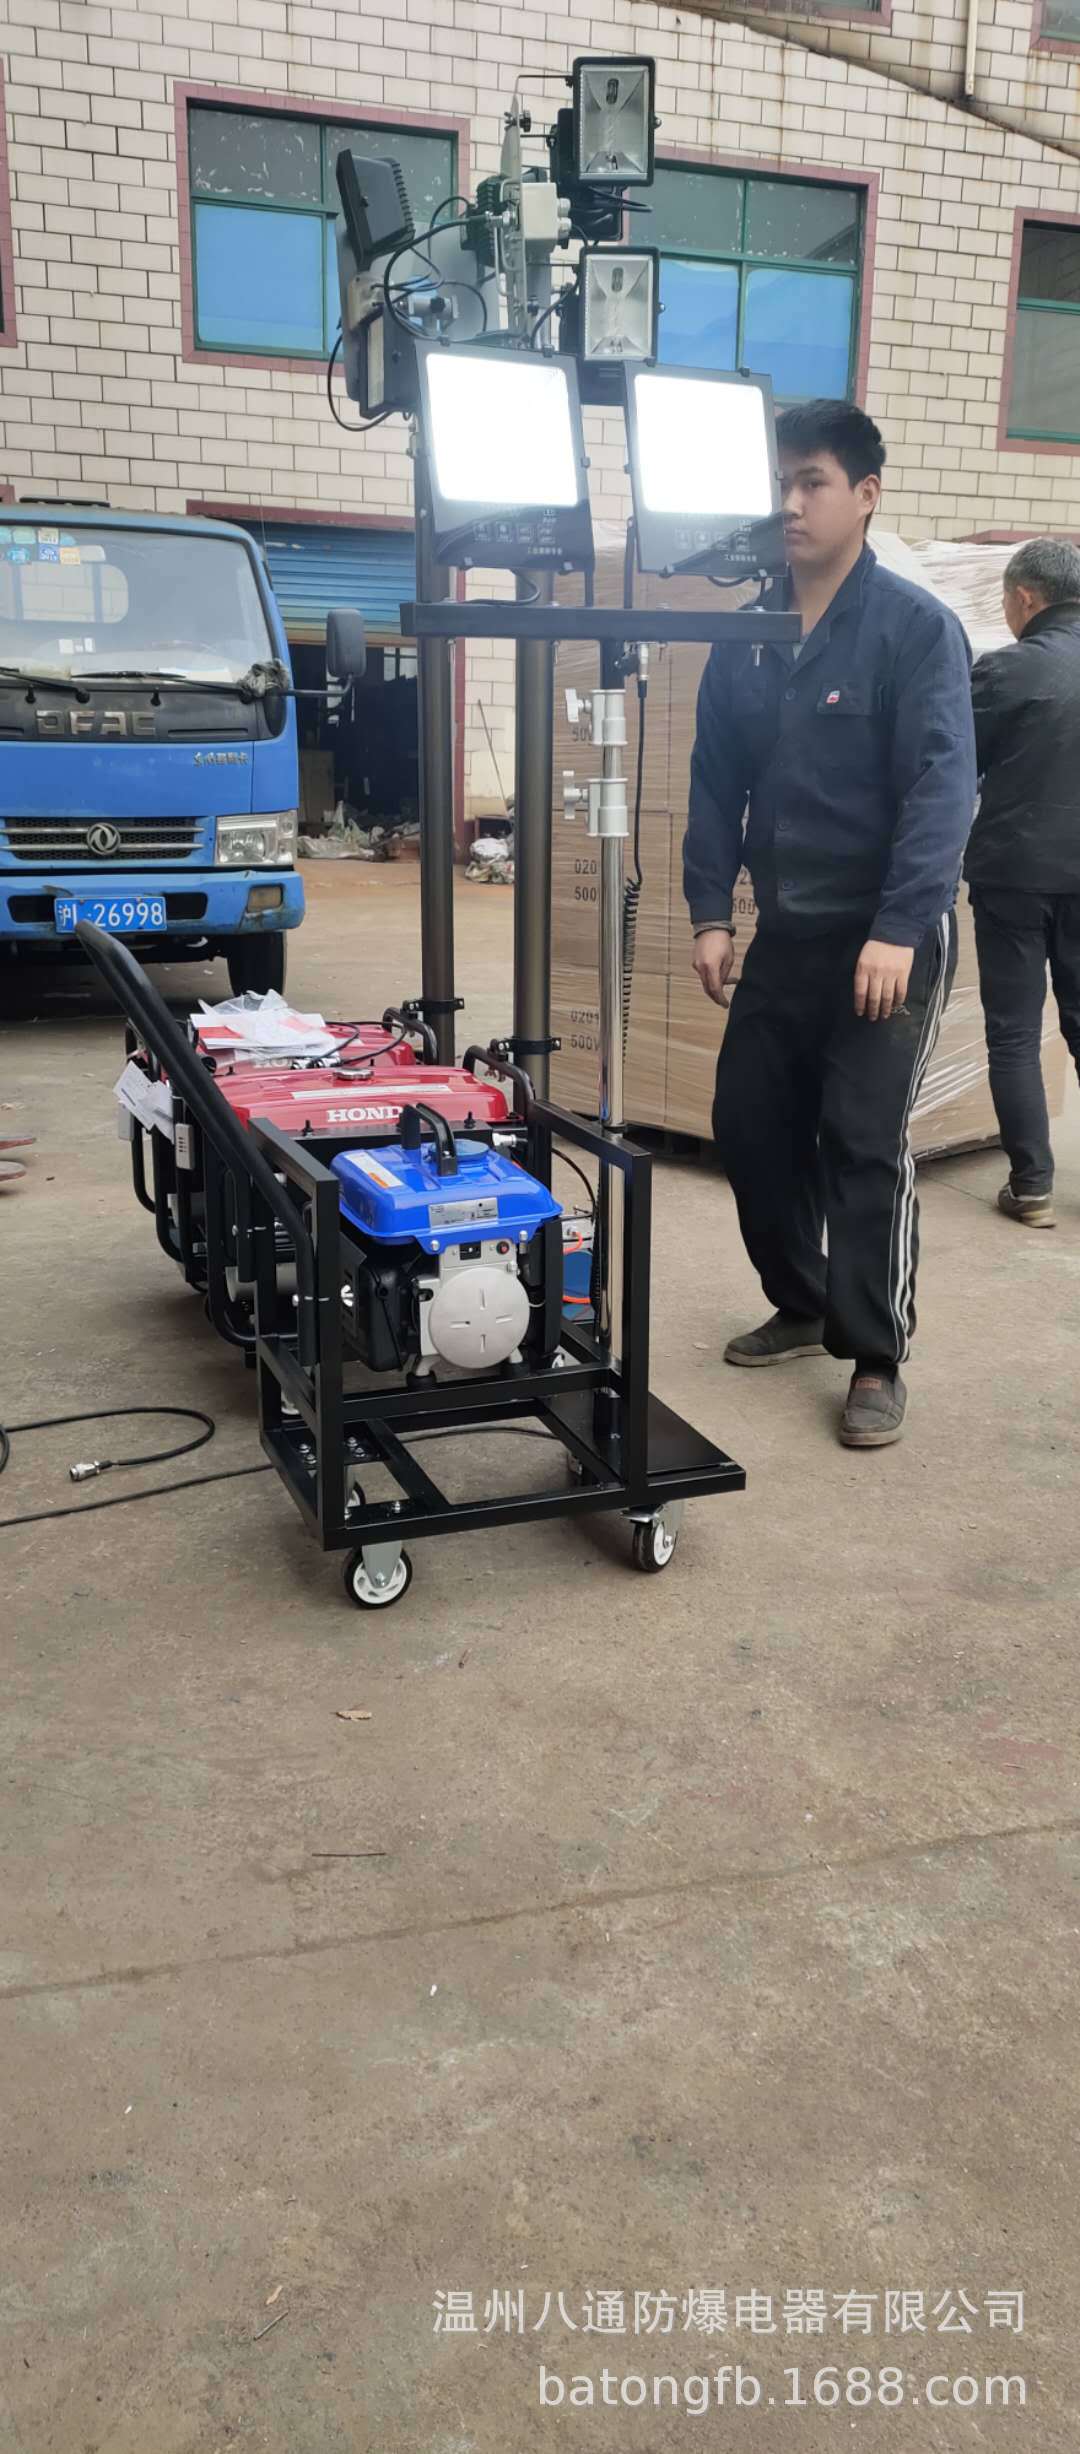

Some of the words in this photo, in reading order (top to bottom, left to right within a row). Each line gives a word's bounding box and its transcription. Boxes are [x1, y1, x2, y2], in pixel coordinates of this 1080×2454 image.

[36, 709, 156, 736] DFAC
[574, 859, 598, 875] 020
[574, 886, 598, 902] 500
[326, 1105, 404, 1123] HOND
